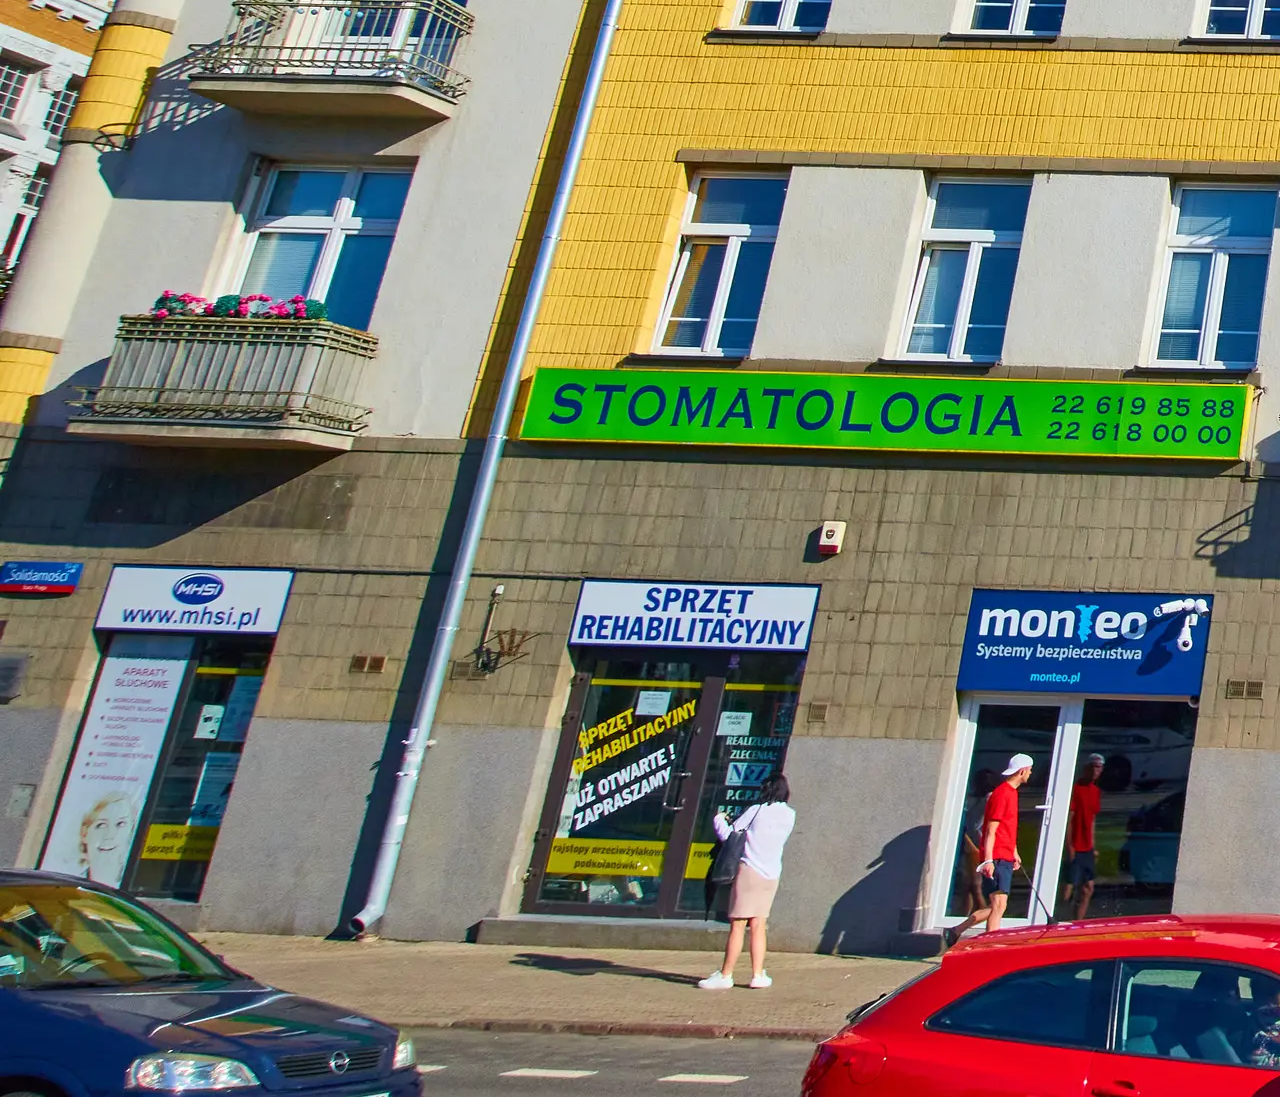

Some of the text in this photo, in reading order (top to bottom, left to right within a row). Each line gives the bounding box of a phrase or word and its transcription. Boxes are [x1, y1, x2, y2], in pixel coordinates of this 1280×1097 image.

[547, 382, 1023, 437] STOMATOLOGIA
[1051, 395, 1235, 418] 22 619 85 88
[1047, 421, 1232, 445] 22 618 00 00
[176, 583, 222, 596] MHSI
[643, 587, 754, 618] SPRZĘT
[122, 606, 261, 630] www.mhsi.pl
[577, 614, 805, 645] REHABILITACYJNY
[978, 605, 1148, 644] monteo
[976, 643, 1143, 661] Systemy bezpieczeństwa
[123, 667, 169, 677] APARATY
[1030, 672, 1081, 684] monteo.pl
[572, 699, 697, 775] REHABILITACYJNY
[577, 707, 635, 750] SPRZĘT
[726, 735, 786, 748] REALIZUJEMY
[729, 749, 778, 760] ZLECENIA:
[597, 747, 668, 796] OTWARTE
[669, 743, 677, 760] !
[573, 766, 672, 831] ZAPRASZAMY
[552, 844, 590, 856] rajstopy
